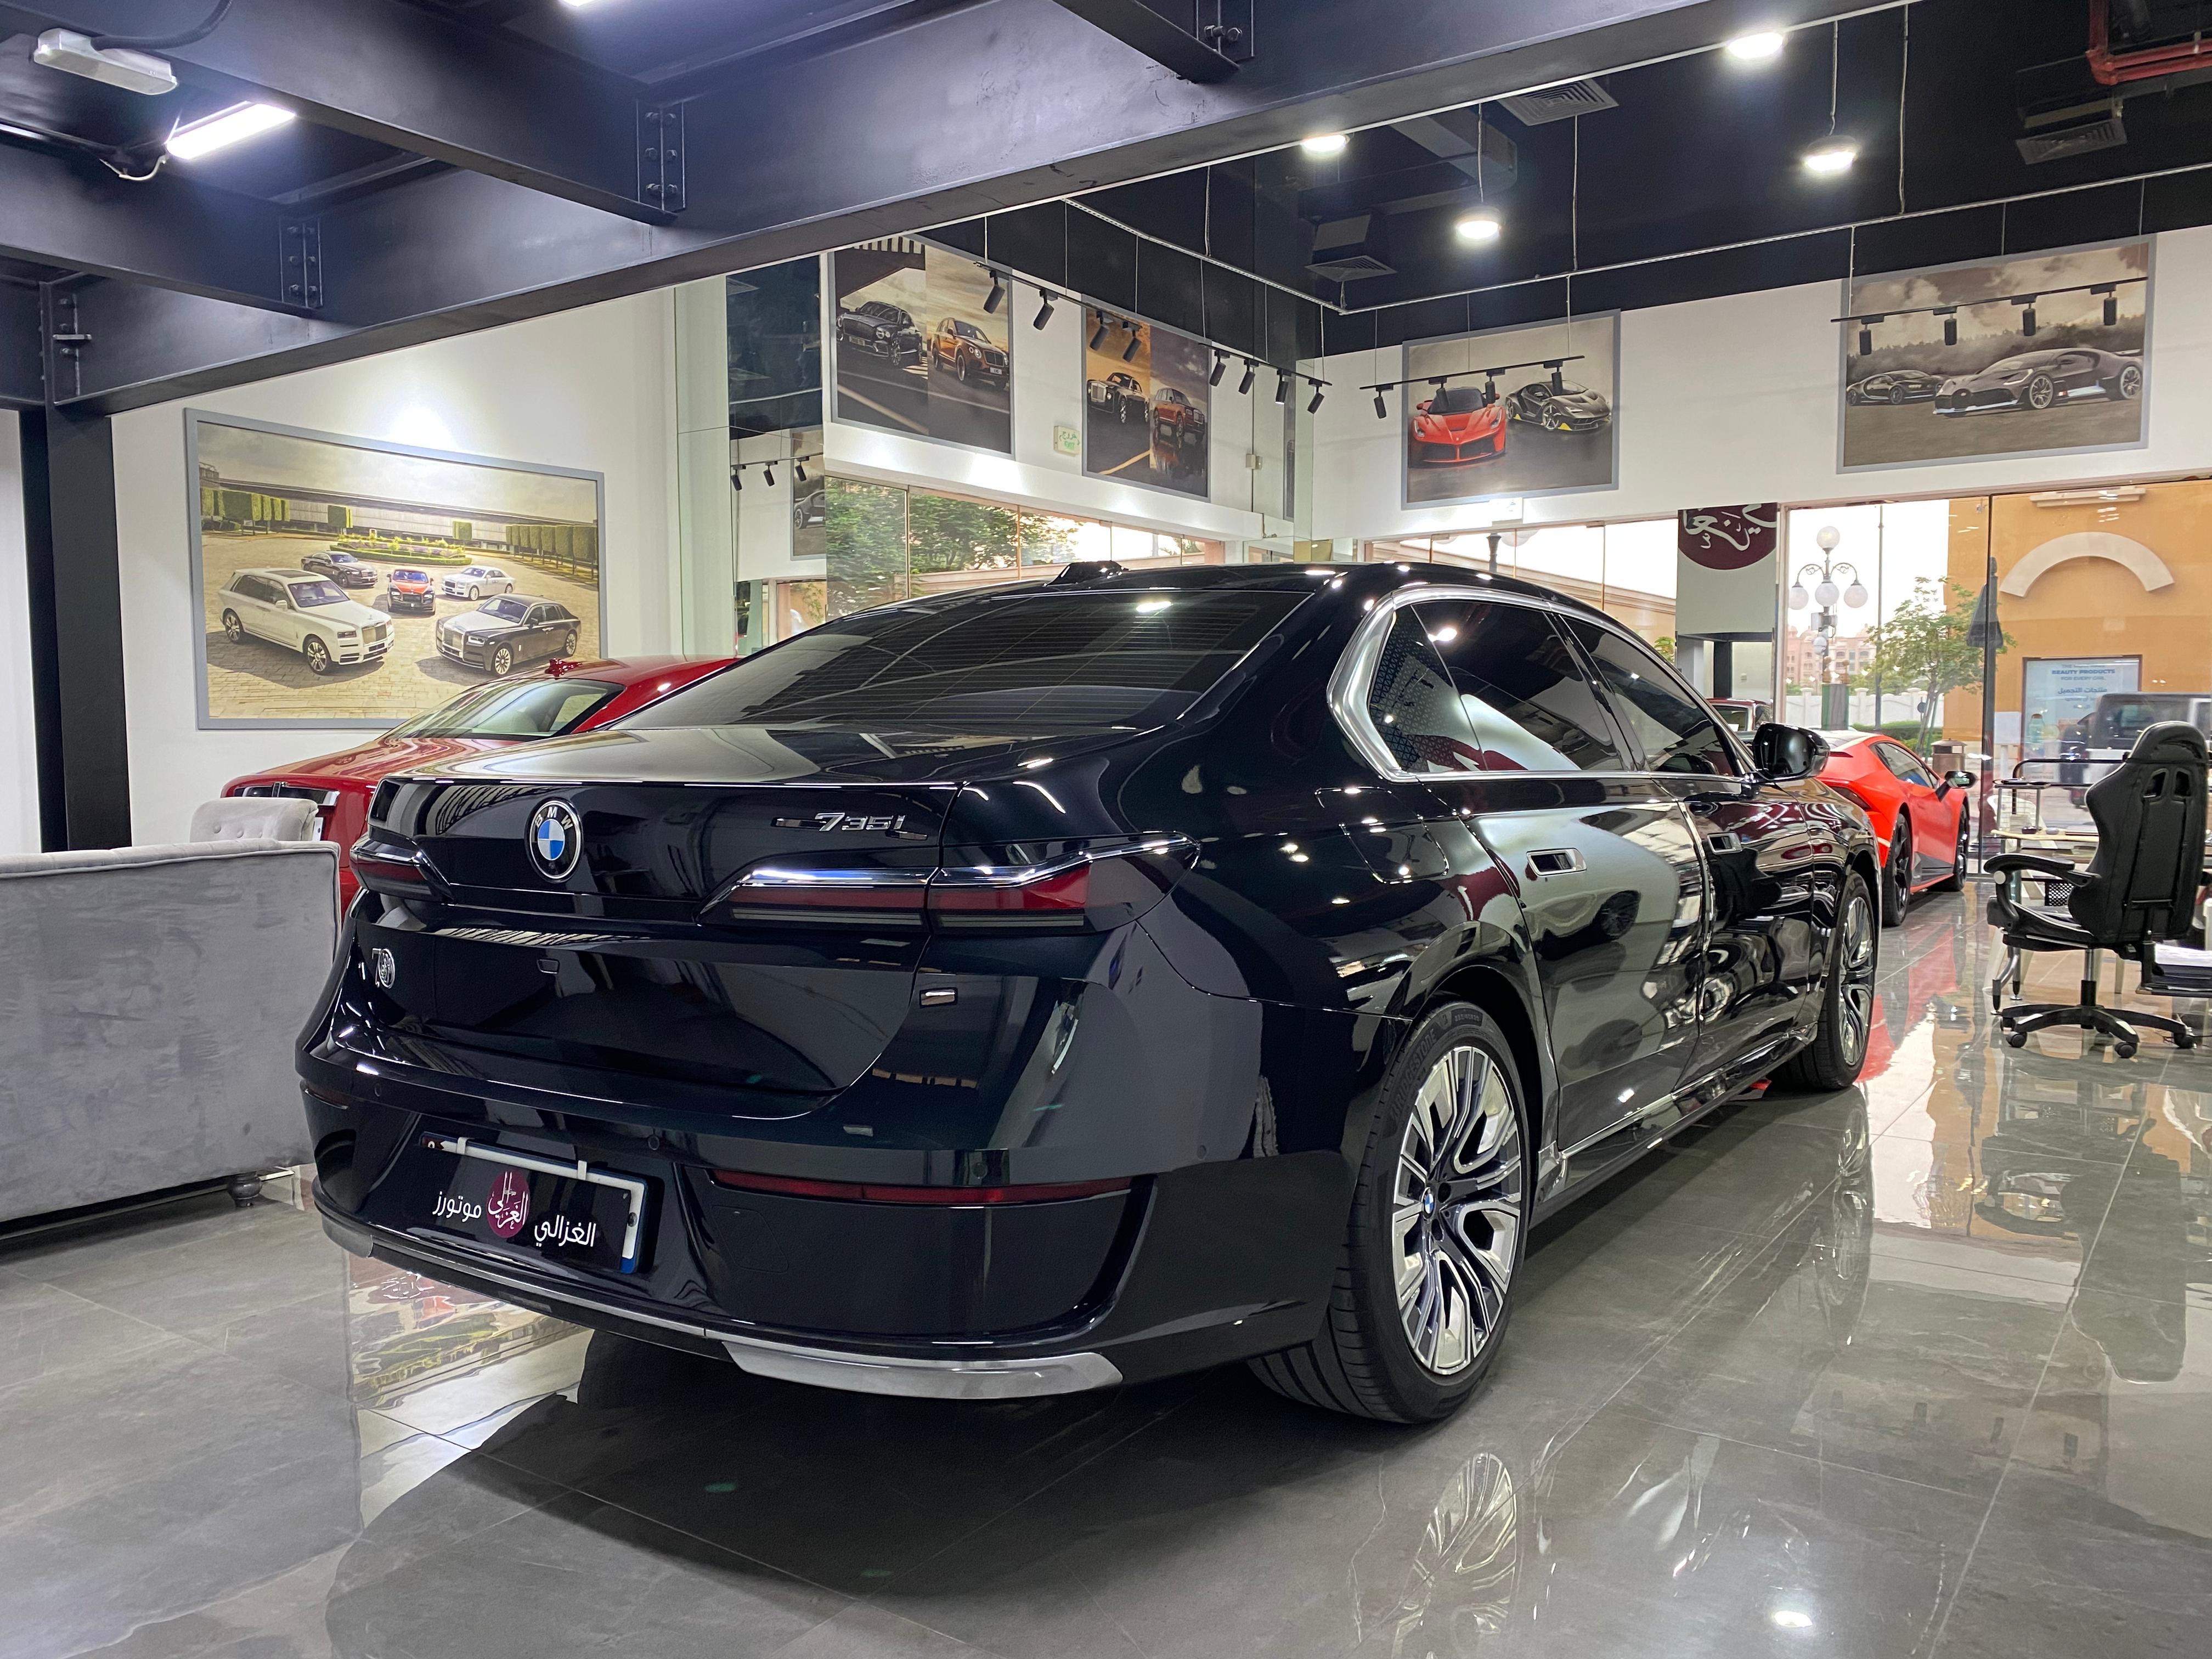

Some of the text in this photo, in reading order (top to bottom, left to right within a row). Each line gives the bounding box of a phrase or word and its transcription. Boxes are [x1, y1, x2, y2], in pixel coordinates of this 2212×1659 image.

[535, 806, 574, 830] BMW
[432, 1191, 597, 1247] الغزالي موتورز
